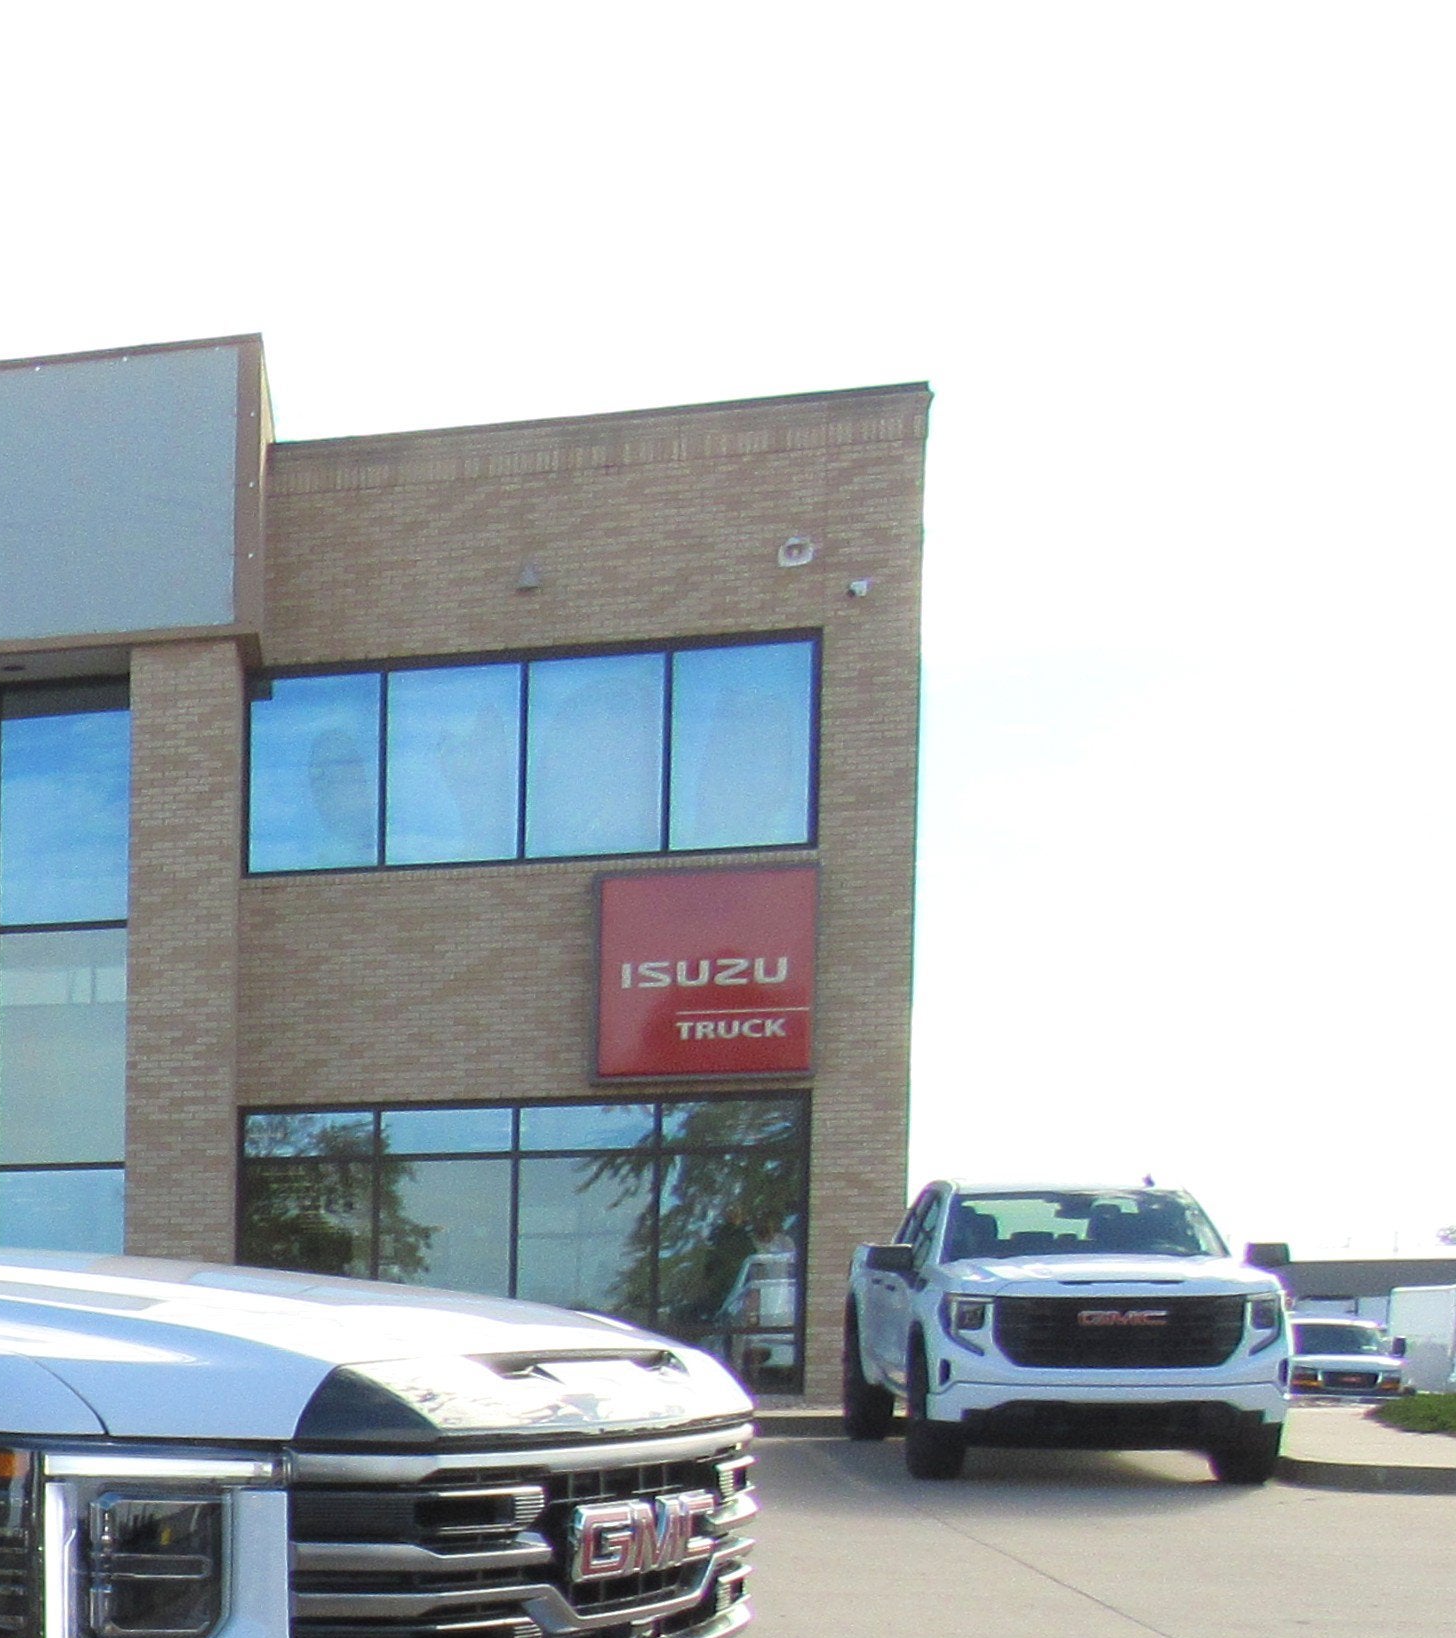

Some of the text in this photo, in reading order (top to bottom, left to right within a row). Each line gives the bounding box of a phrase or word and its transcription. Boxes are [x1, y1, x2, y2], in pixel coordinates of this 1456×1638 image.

[621, 956, 788, 989] ISUZU
[676, 1018, 786, 1040] TRUCK
[1077, 1310, 1168, 1326] GMC
[571, 1489, 716, 1583] GMC
